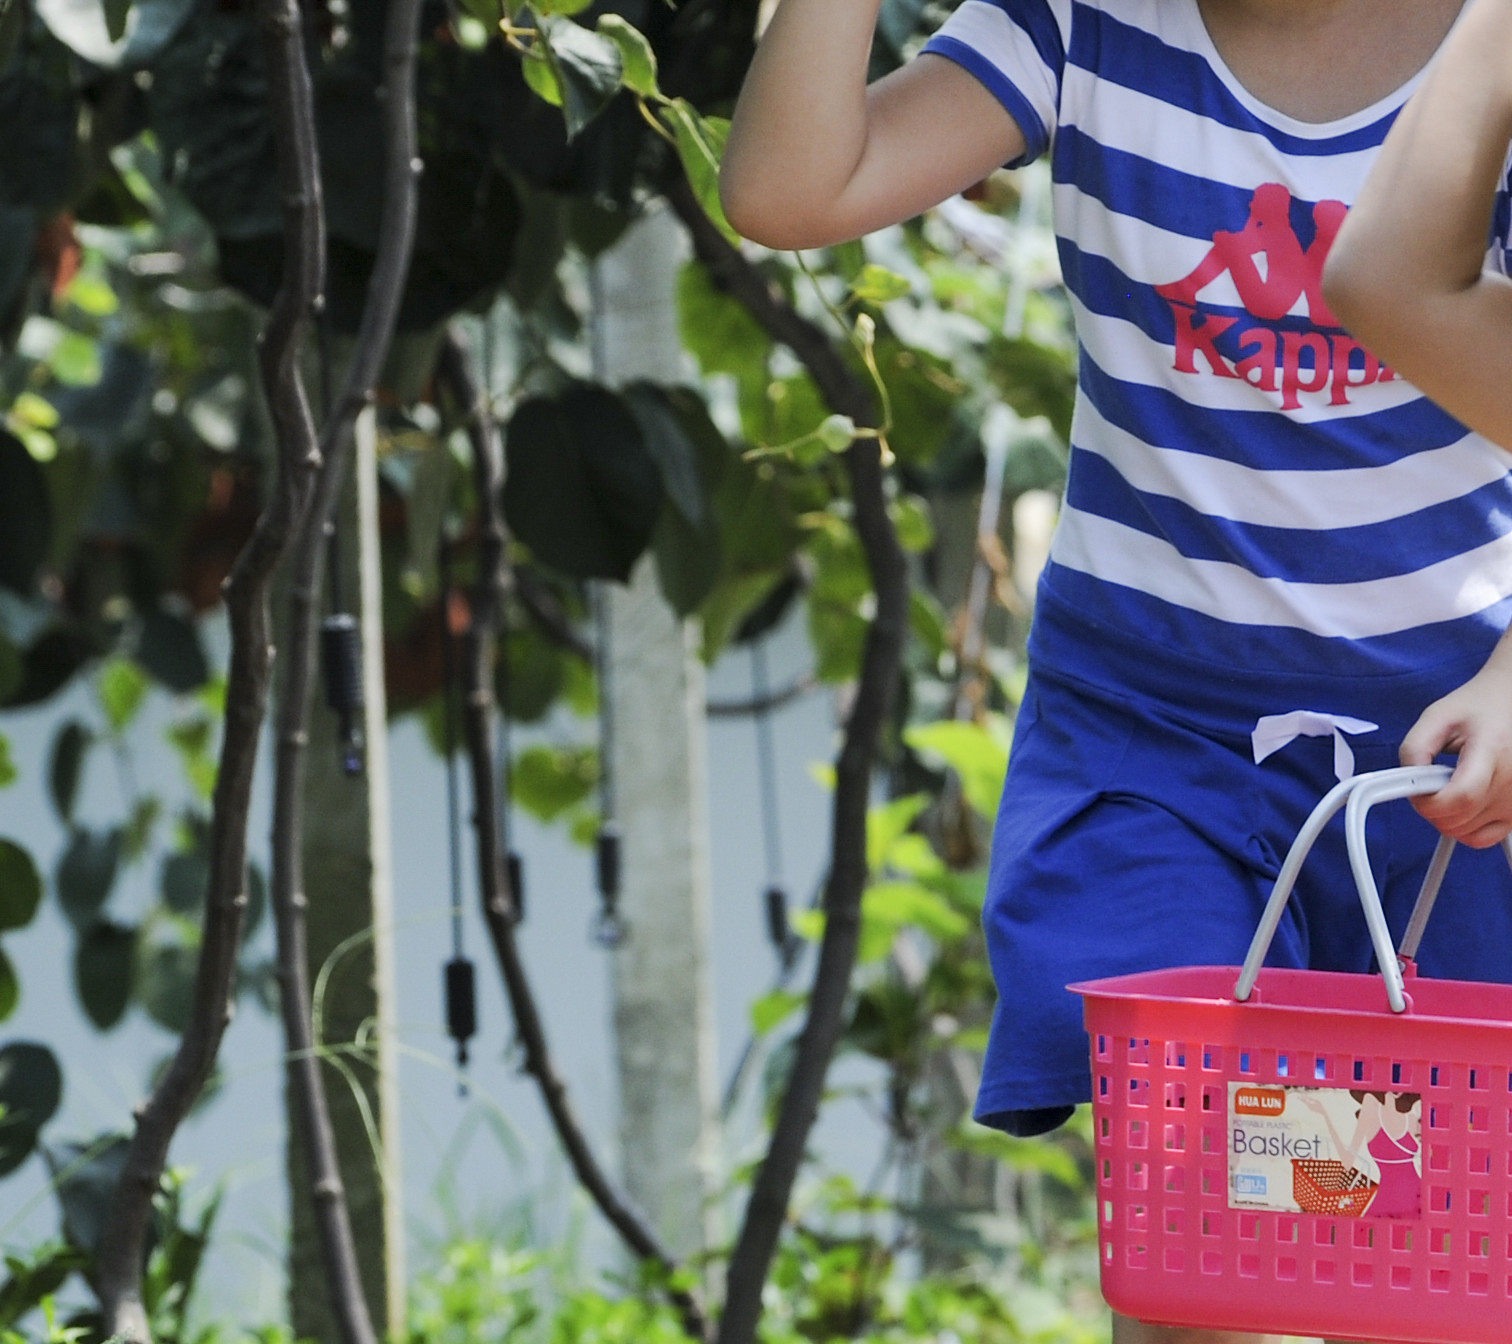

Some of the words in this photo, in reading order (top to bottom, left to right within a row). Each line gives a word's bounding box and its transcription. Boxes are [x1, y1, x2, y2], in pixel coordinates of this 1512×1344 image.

[1238, 1095, 1260, 1108] HUA
[1261, 1097, 1282, 1109] LUN
[1233, 1129, 1321, 1159] Basket
